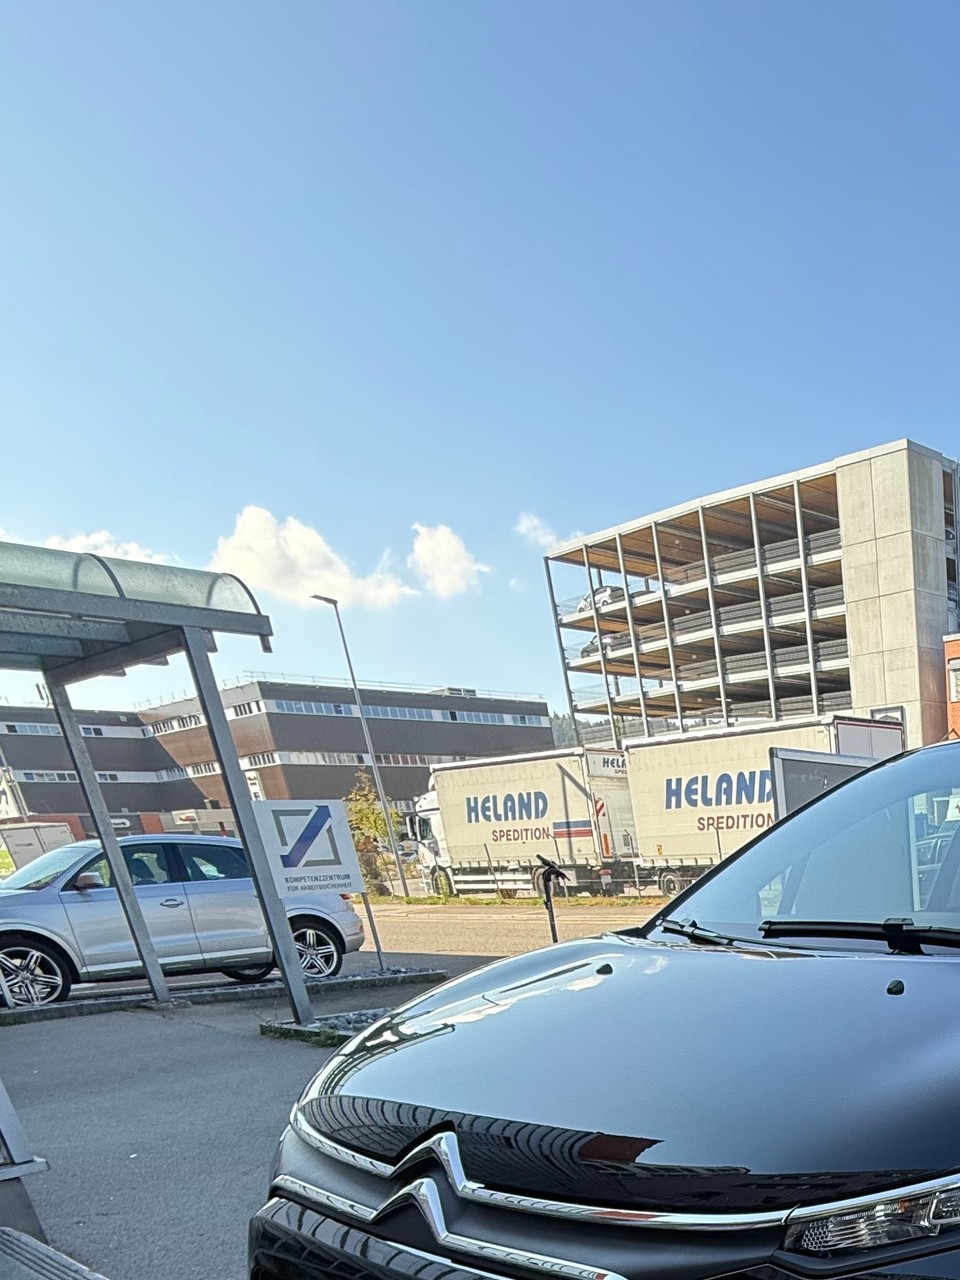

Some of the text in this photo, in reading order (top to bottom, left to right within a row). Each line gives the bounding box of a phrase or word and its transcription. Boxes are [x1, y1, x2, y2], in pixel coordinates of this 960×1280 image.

[602, 757, 627, 768] HELA
[665, 769, 773, 809] HELAND
[466, 791, 548, 823] HELAND
[697, 813, 776, 831] SPEDITION
[492, 827, 549, 842] SPEDITION
[284, 873, 351, 884] KOMPETENZZENTRUM
[287, 884, 300, 892] FÜR
